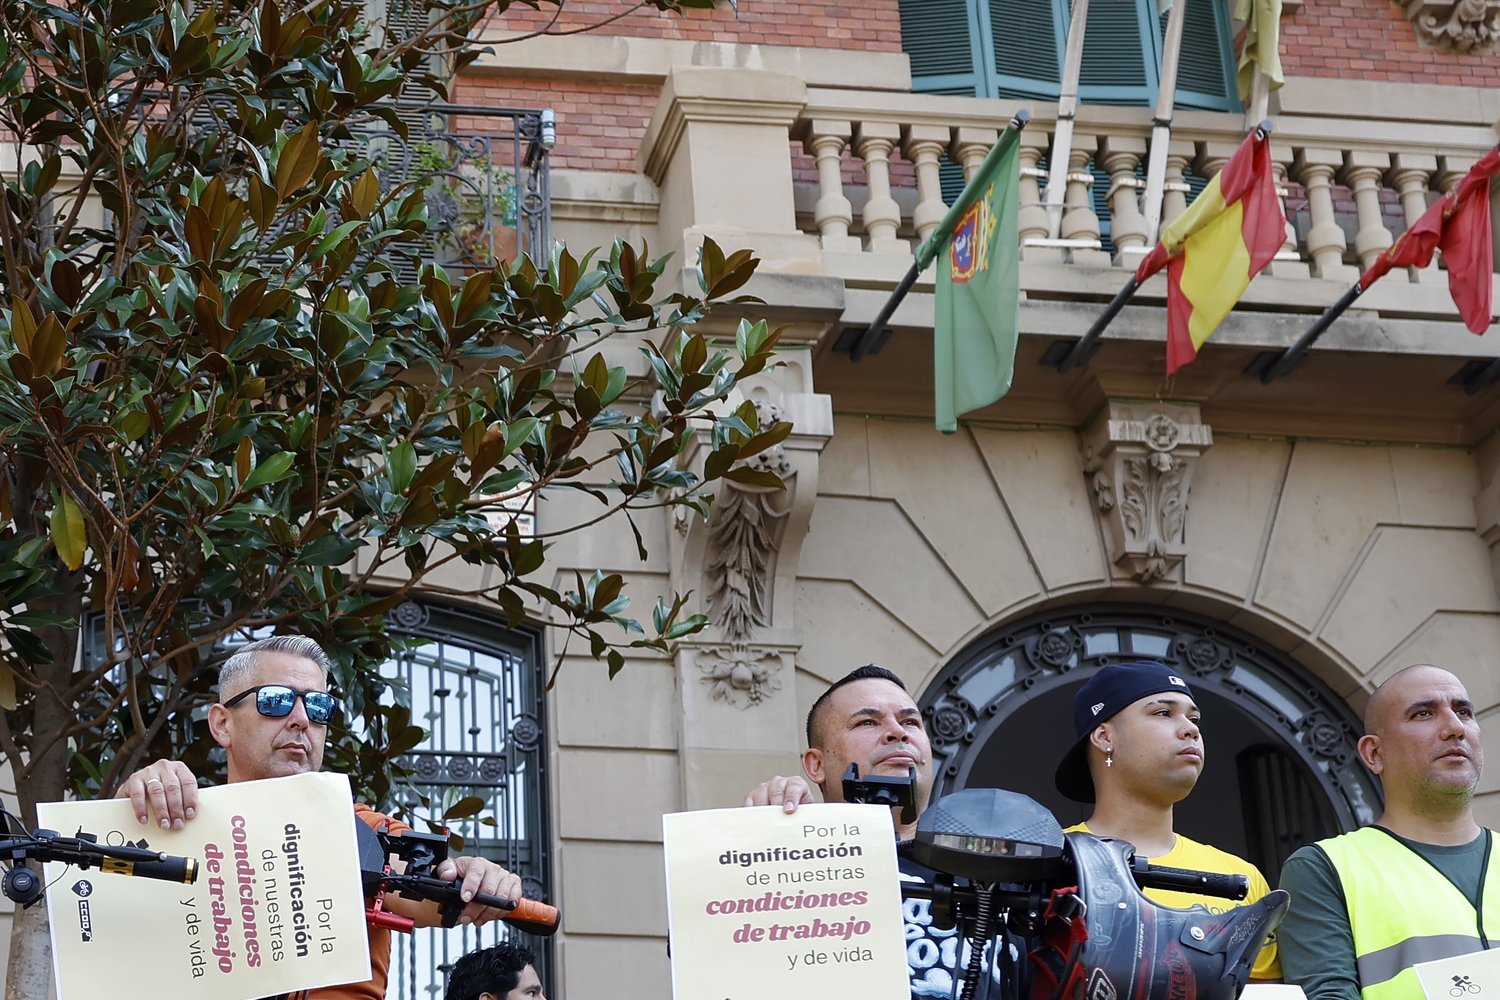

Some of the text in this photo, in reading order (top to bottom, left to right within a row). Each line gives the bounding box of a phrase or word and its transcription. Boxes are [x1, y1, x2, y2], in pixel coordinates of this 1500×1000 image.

[803, 823, 860, 838] Por la
[719, 843, 862, 867] dignificación
[746, 866, 865, 886] de nuestras
[204, 843, 236, 974] de trabajo
[231, 815, 262, 968] condiciones
[261, 848, 284, 961] de nuestras
[281, 823, 313, 958] dignificación
[706, 890, 868, 915] condiciones
[179, 897, 207, 978] y de vida
[316, 898, 335, 954] Por la
[733, 916, 871, 944] de trabajo
[787, 947, 873, 970] y de vida
